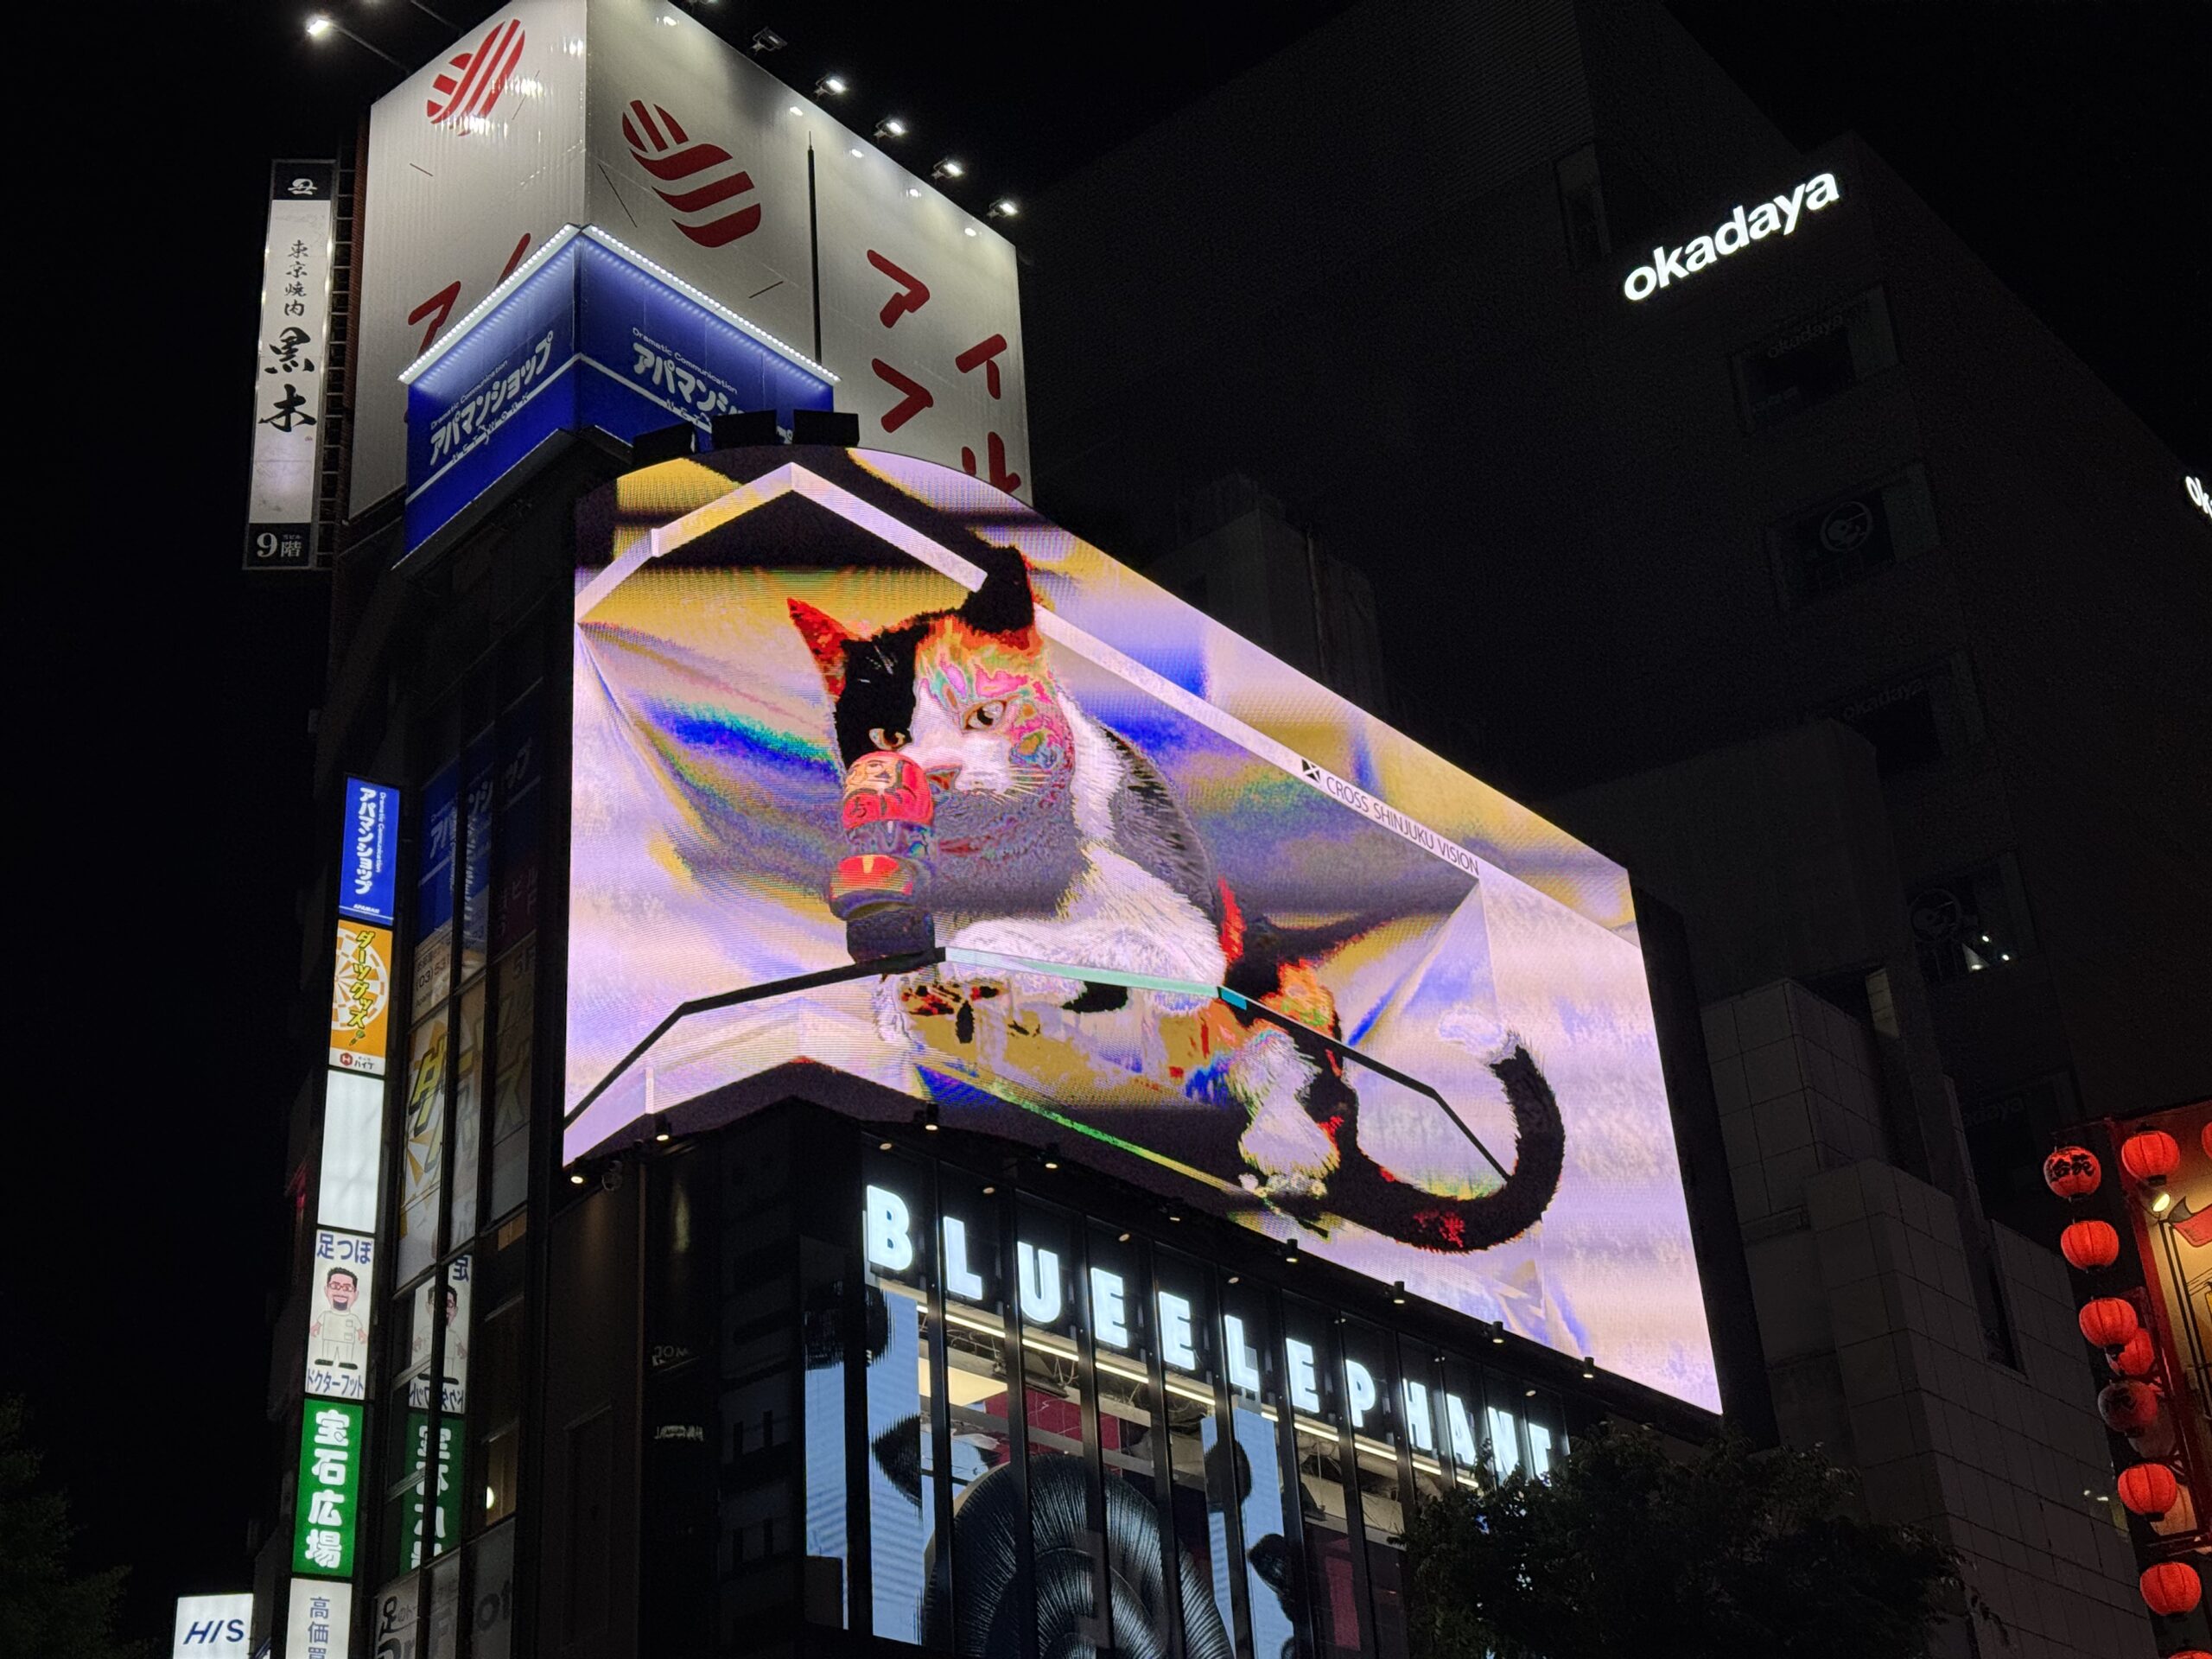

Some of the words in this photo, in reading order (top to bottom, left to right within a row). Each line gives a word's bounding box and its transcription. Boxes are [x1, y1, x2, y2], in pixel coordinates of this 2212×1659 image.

[1624, 173, 1840, 301] okadaya
[257, 327, 317, 432] 黒木
[429, 330, 554, 466] アパマンショップ
[430, 402, 460, 429] Dramatic
[460, 359, 508, 403] Communication
[632, 327, 672, 358] Dramatic
[674, 352, 737, 394] Communication
[354, 787, 377, 895] アパマンショップ
[1326, 776, 1370, 812] CROSS
[1373, 802, 1433, 849] SHINJUKU
[1437, 838, 1479, 876] VISION
[317, 1233, 372, 1265] 足つぼ
[307, 1368, 364, 1397] ドクターフット
[304, 1409, 350, 1568] 宝石広場
